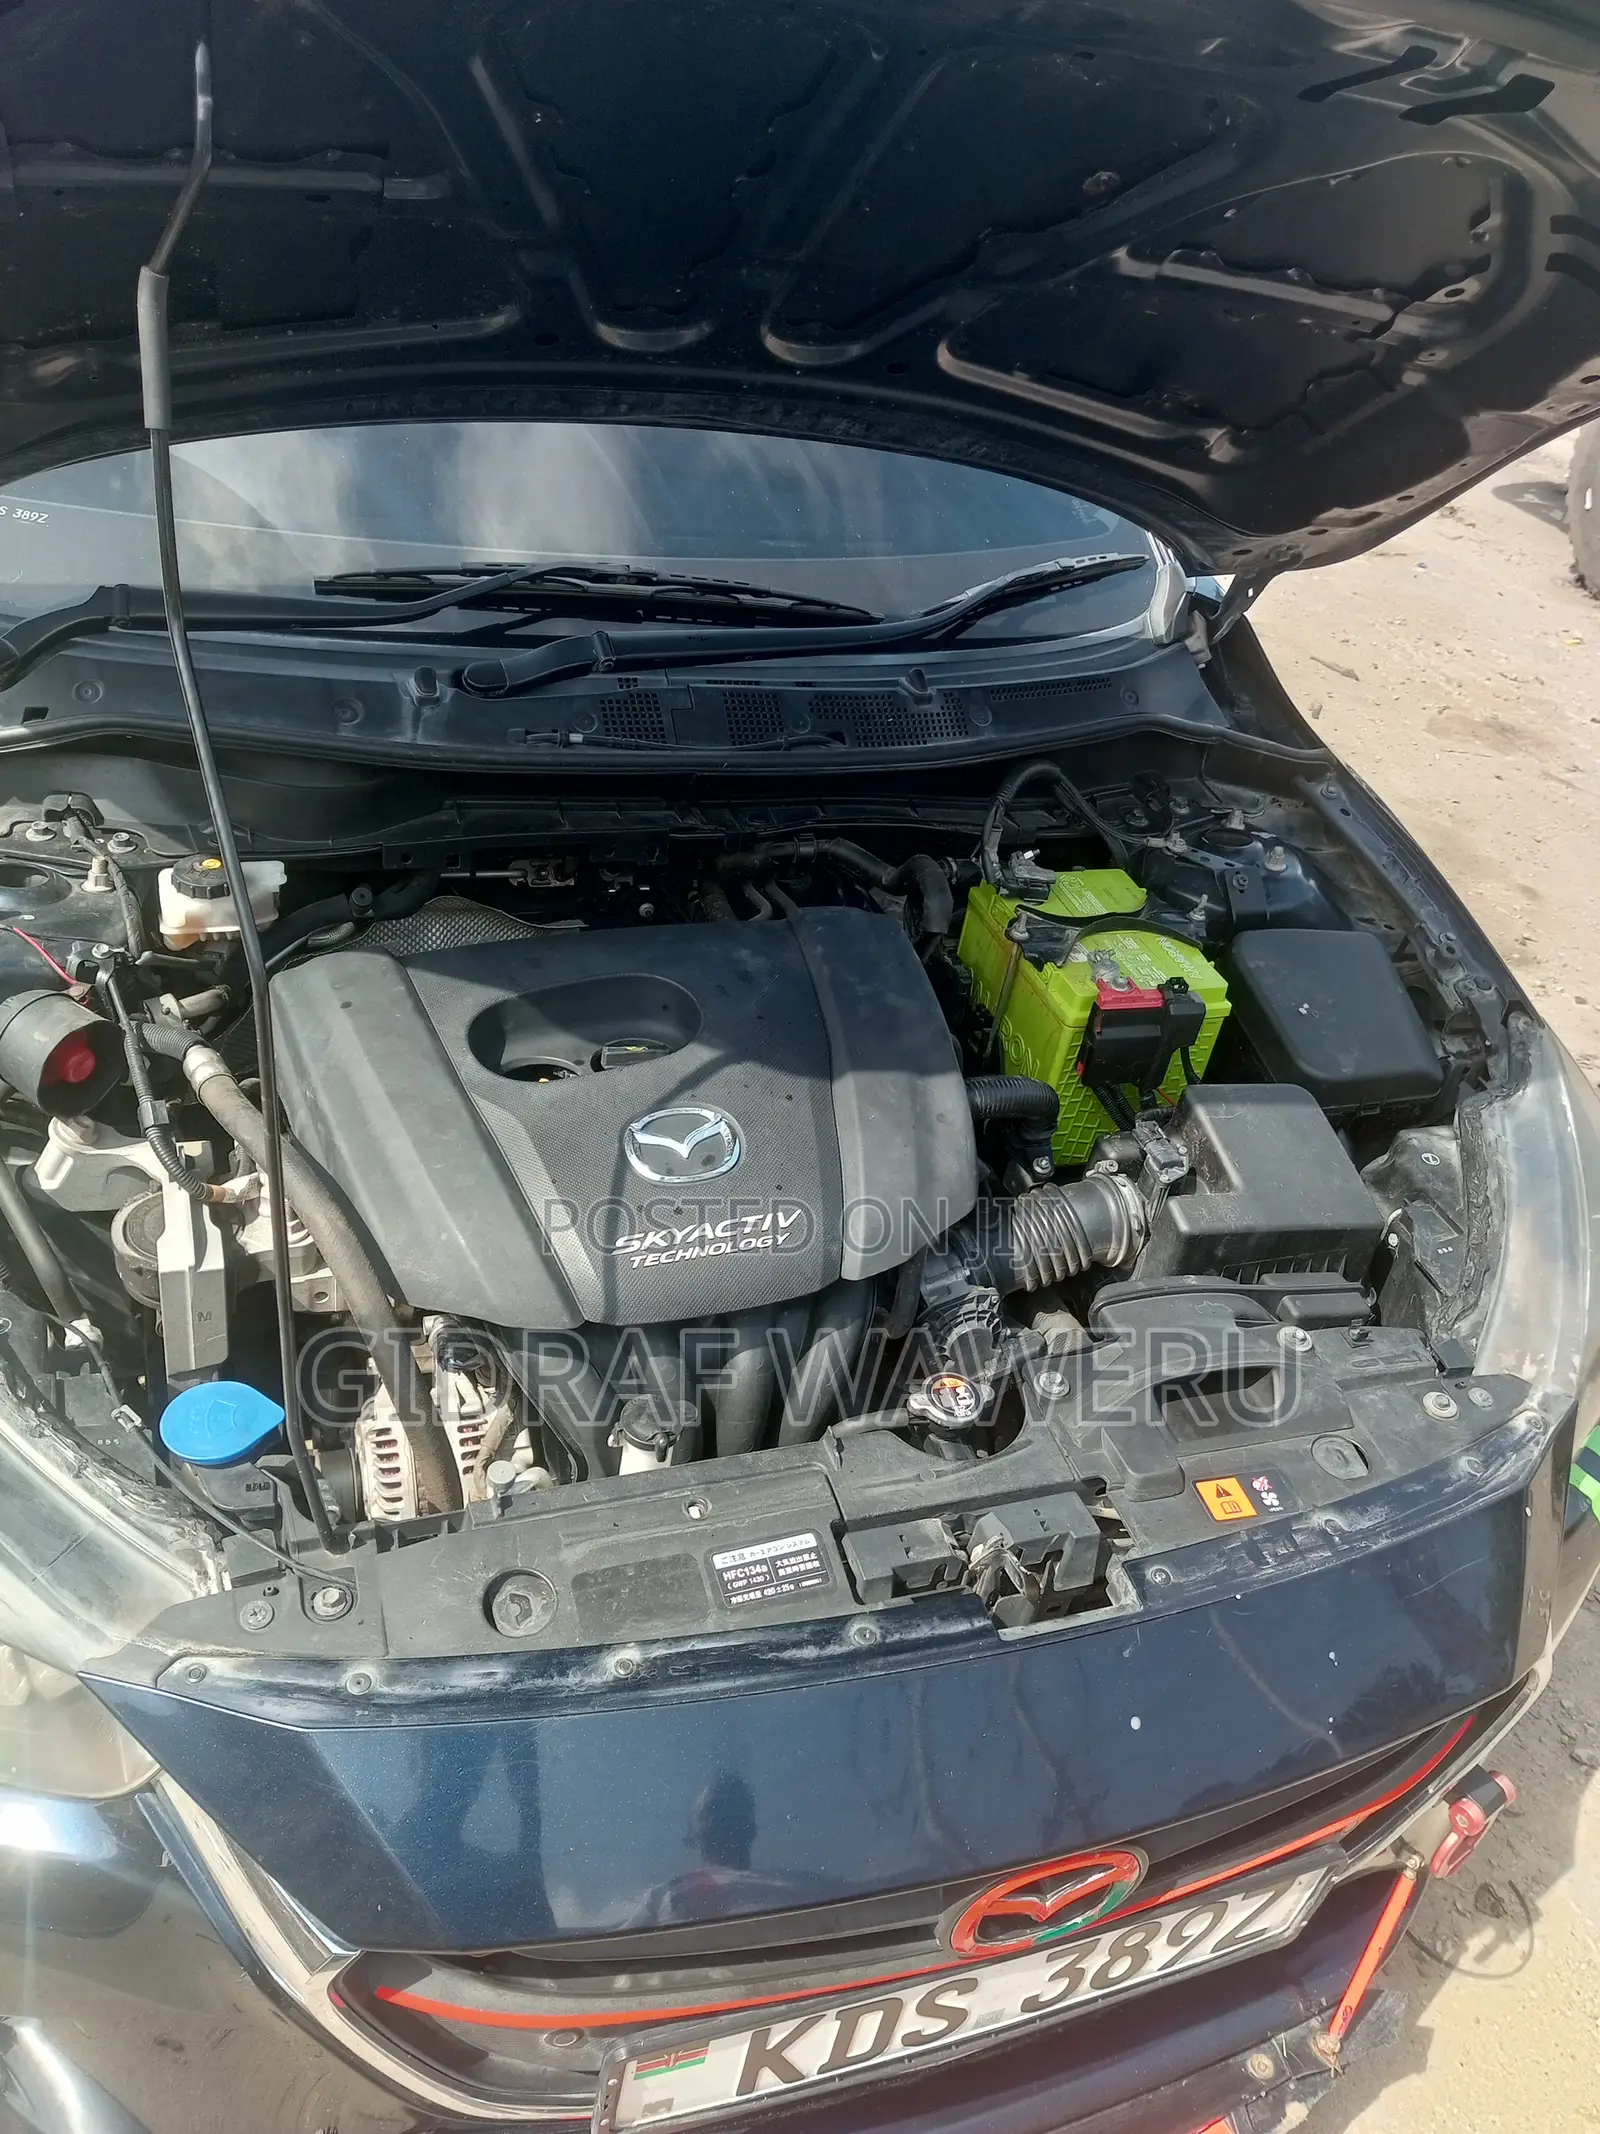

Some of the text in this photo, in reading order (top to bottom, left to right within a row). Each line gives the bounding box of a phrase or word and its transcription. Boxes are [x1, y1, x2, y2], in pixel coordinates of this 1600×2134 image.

[12, 508, 49, 524] 389Z
[611, 1209, 802, 1255] SKYACTIV
[630, 1233, 790, 1269] TECHNOLOGY
[722, 1564, 768, 1581] HFC134a
[735, 1887, 1279, 2096] KDS 389Z
